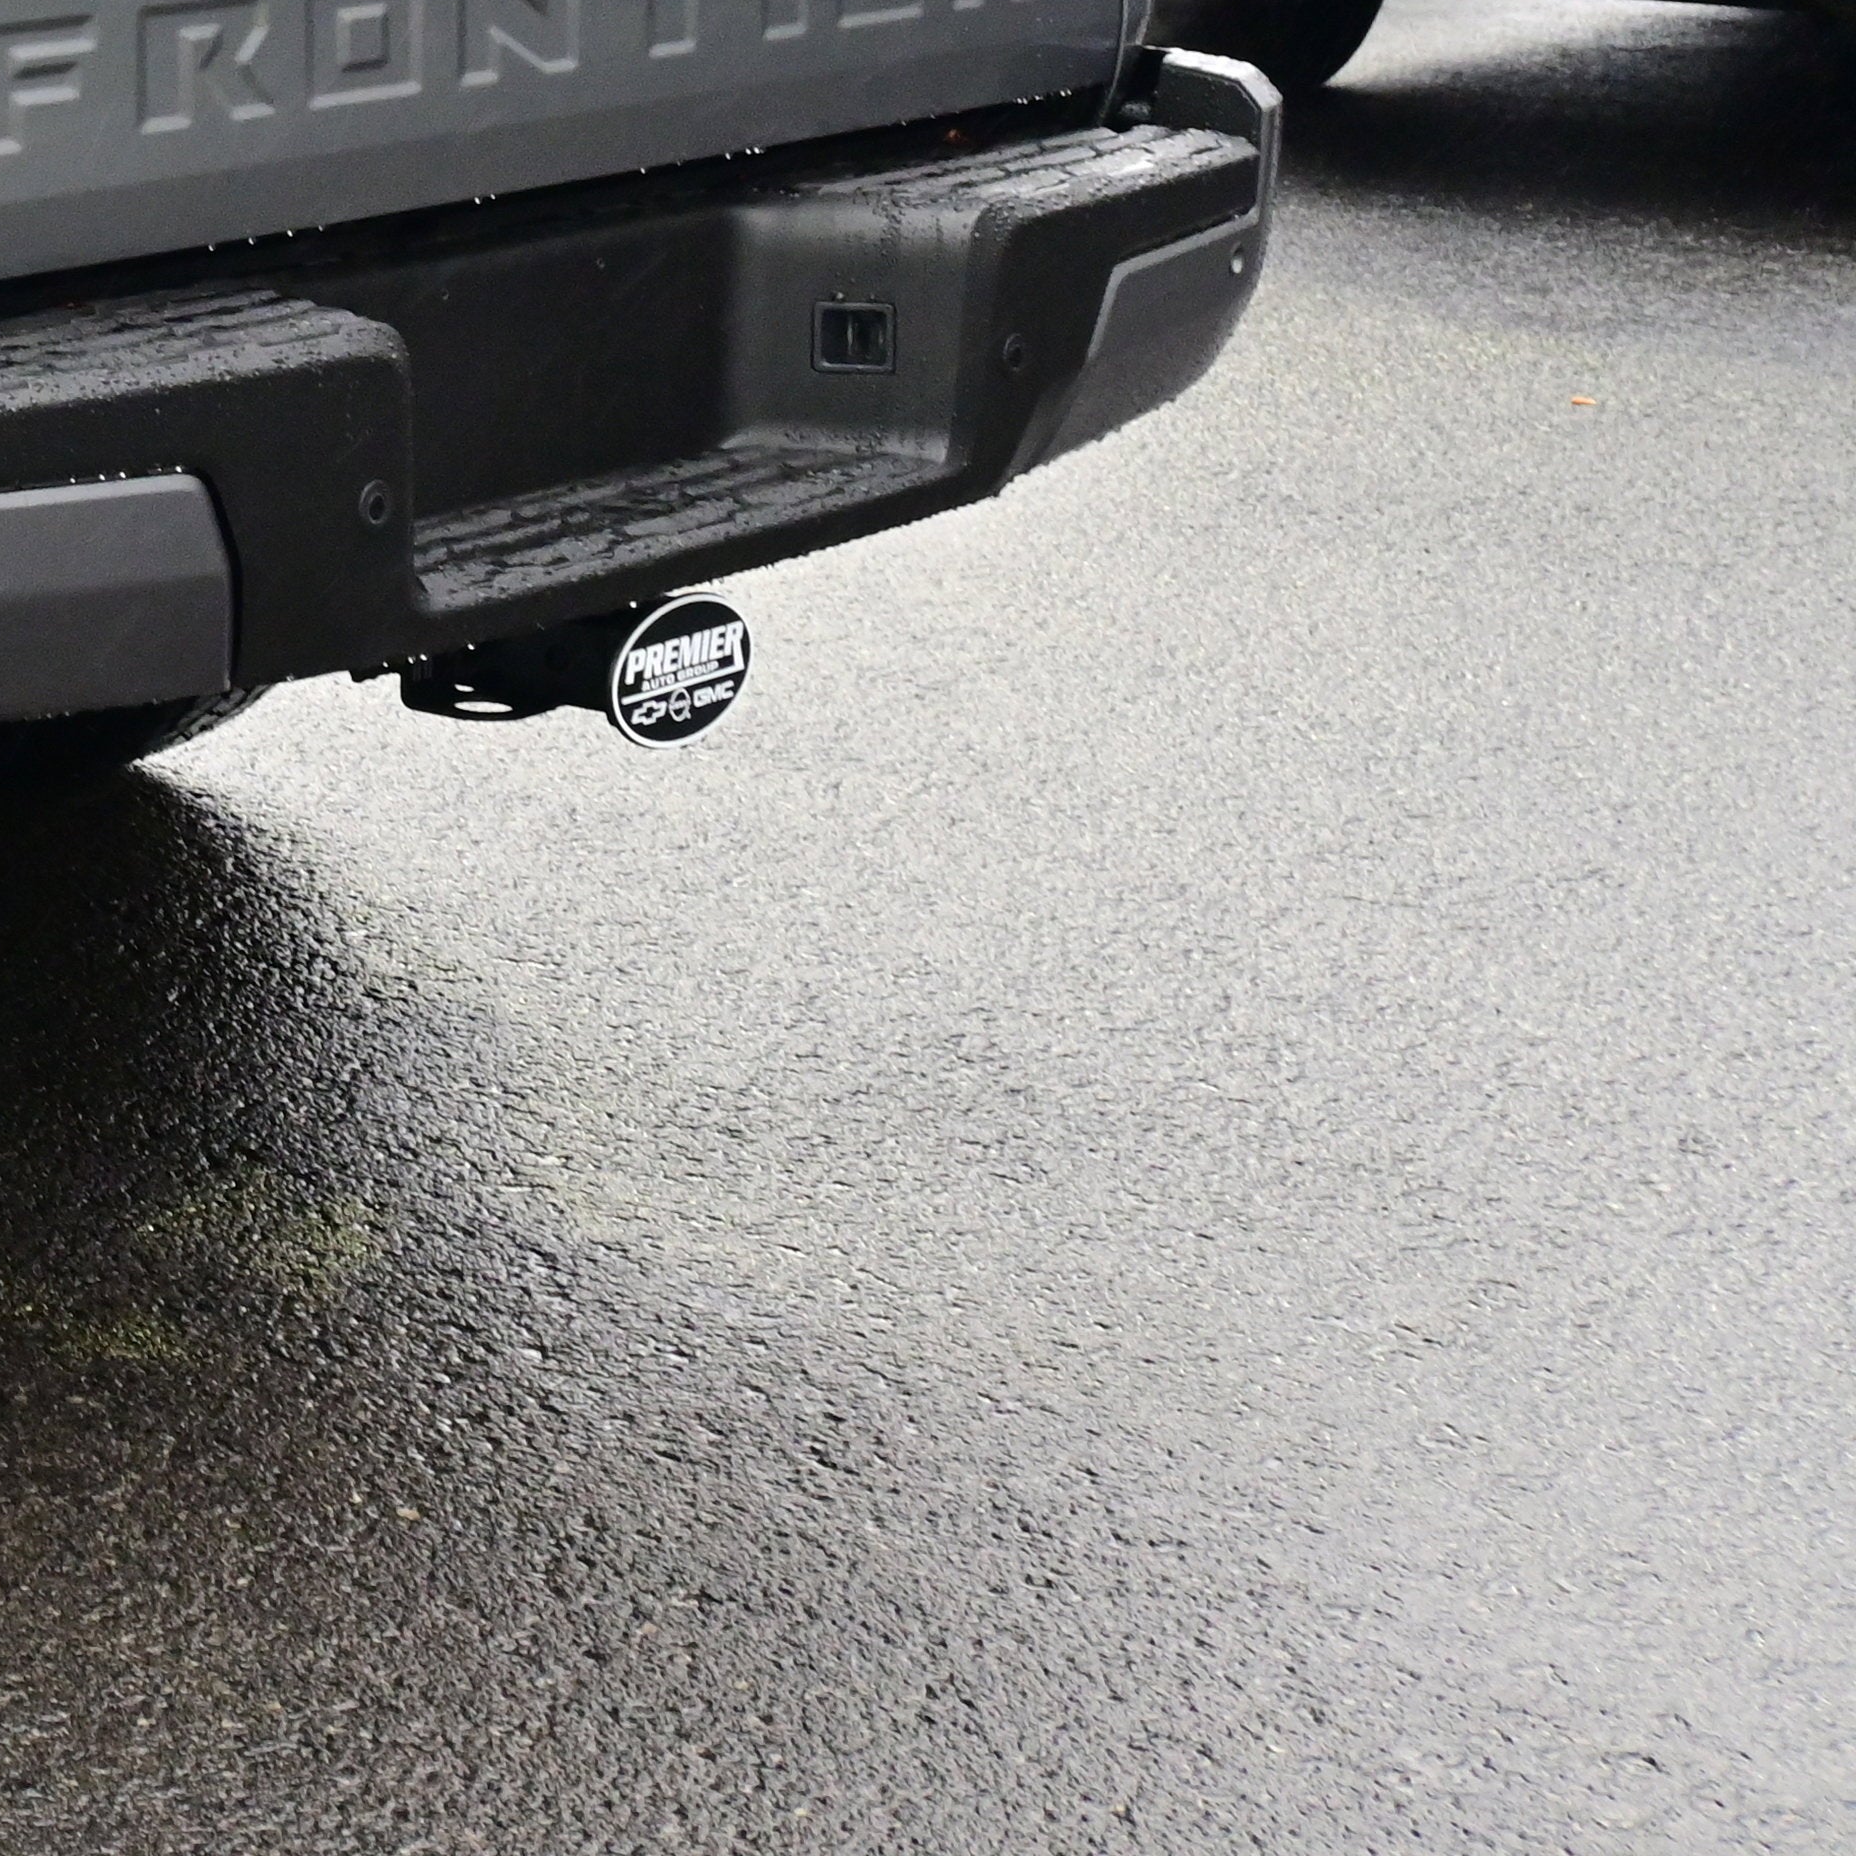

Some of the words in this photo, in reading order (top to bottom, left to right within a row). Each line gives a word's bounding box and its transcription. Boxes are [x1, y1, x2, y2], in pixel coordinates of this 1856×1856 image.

[624, 619, 745, 685] PREMIER
[641, 673, 676, 692] AUTO
[676, 660, 720, 681] GROUP
[692, 679, 735, 708] GMC
